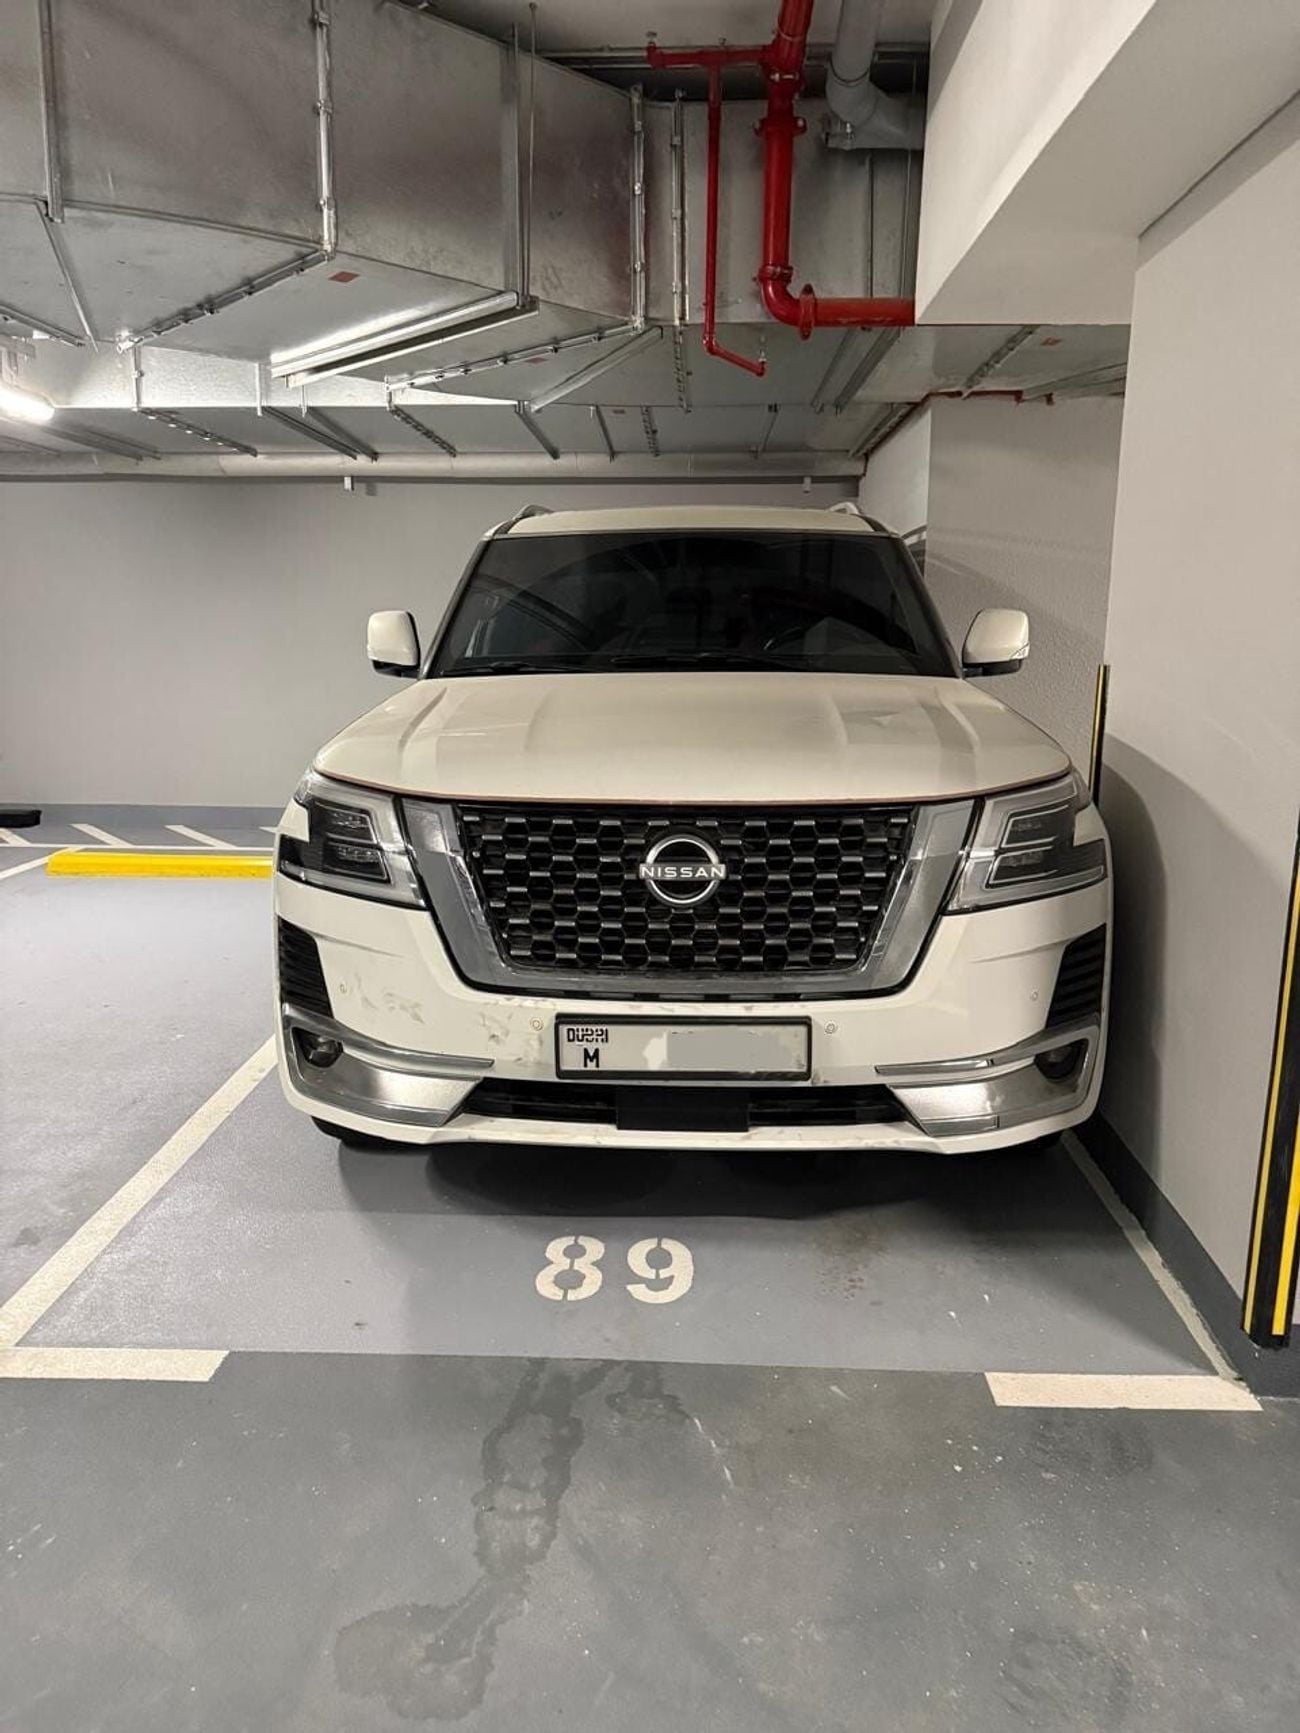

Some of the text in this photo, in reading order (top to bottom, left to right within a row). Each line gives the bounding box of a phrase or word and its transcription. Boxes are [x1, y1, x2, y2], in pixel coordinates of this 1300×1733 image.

[641, 866, 724, 878] NISSAN
[567, 1027, 608, 1043] DUBAI
[583, 1047, 600, 1068] M
[535, 1235, 694, 1304] 89
